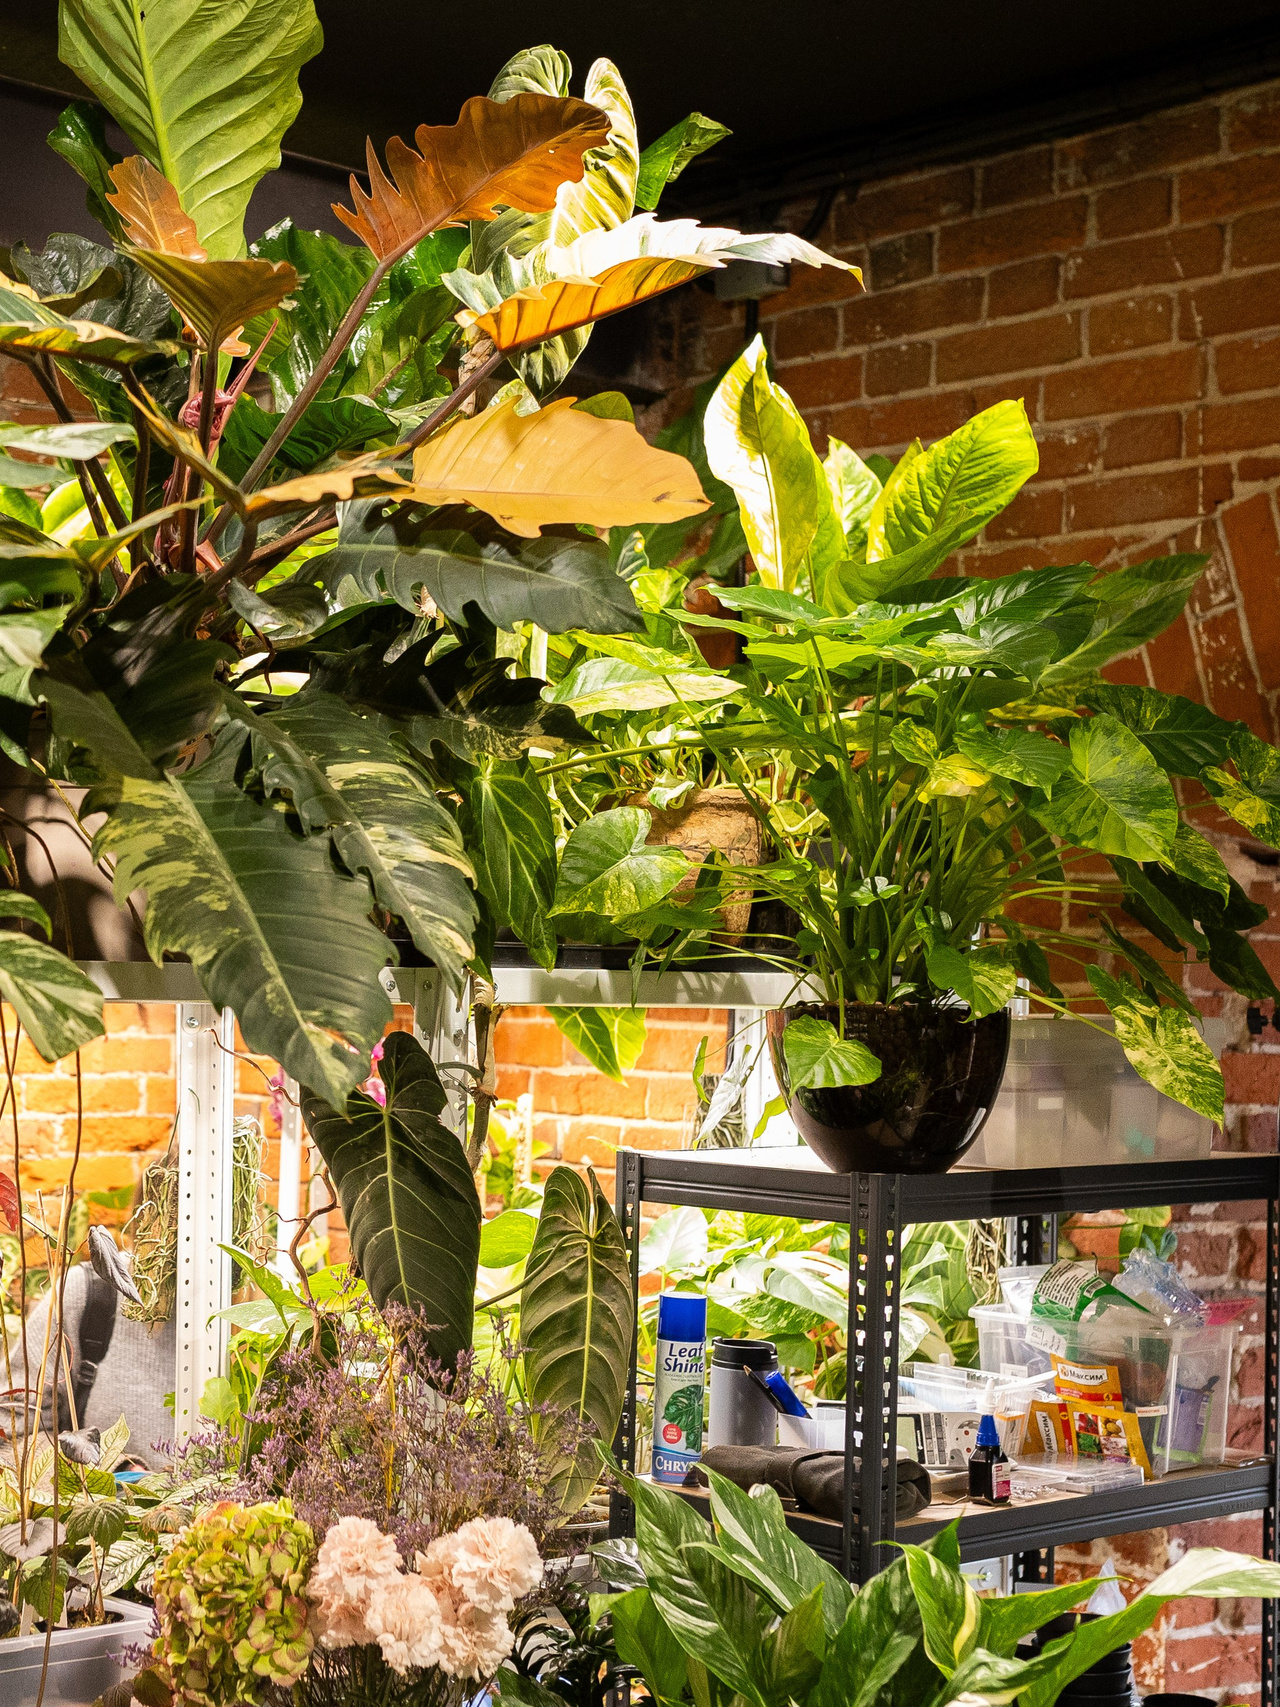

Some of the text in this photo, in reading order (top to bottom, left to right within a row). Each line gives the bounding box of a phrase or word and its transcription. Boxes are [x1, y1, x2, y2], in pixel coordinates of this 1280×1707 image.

[669, 1342, 703, 1358] Leaf
[663, 1357, 704, 1374] Shine
[1069, 1369, 1104, 1381] Максим
